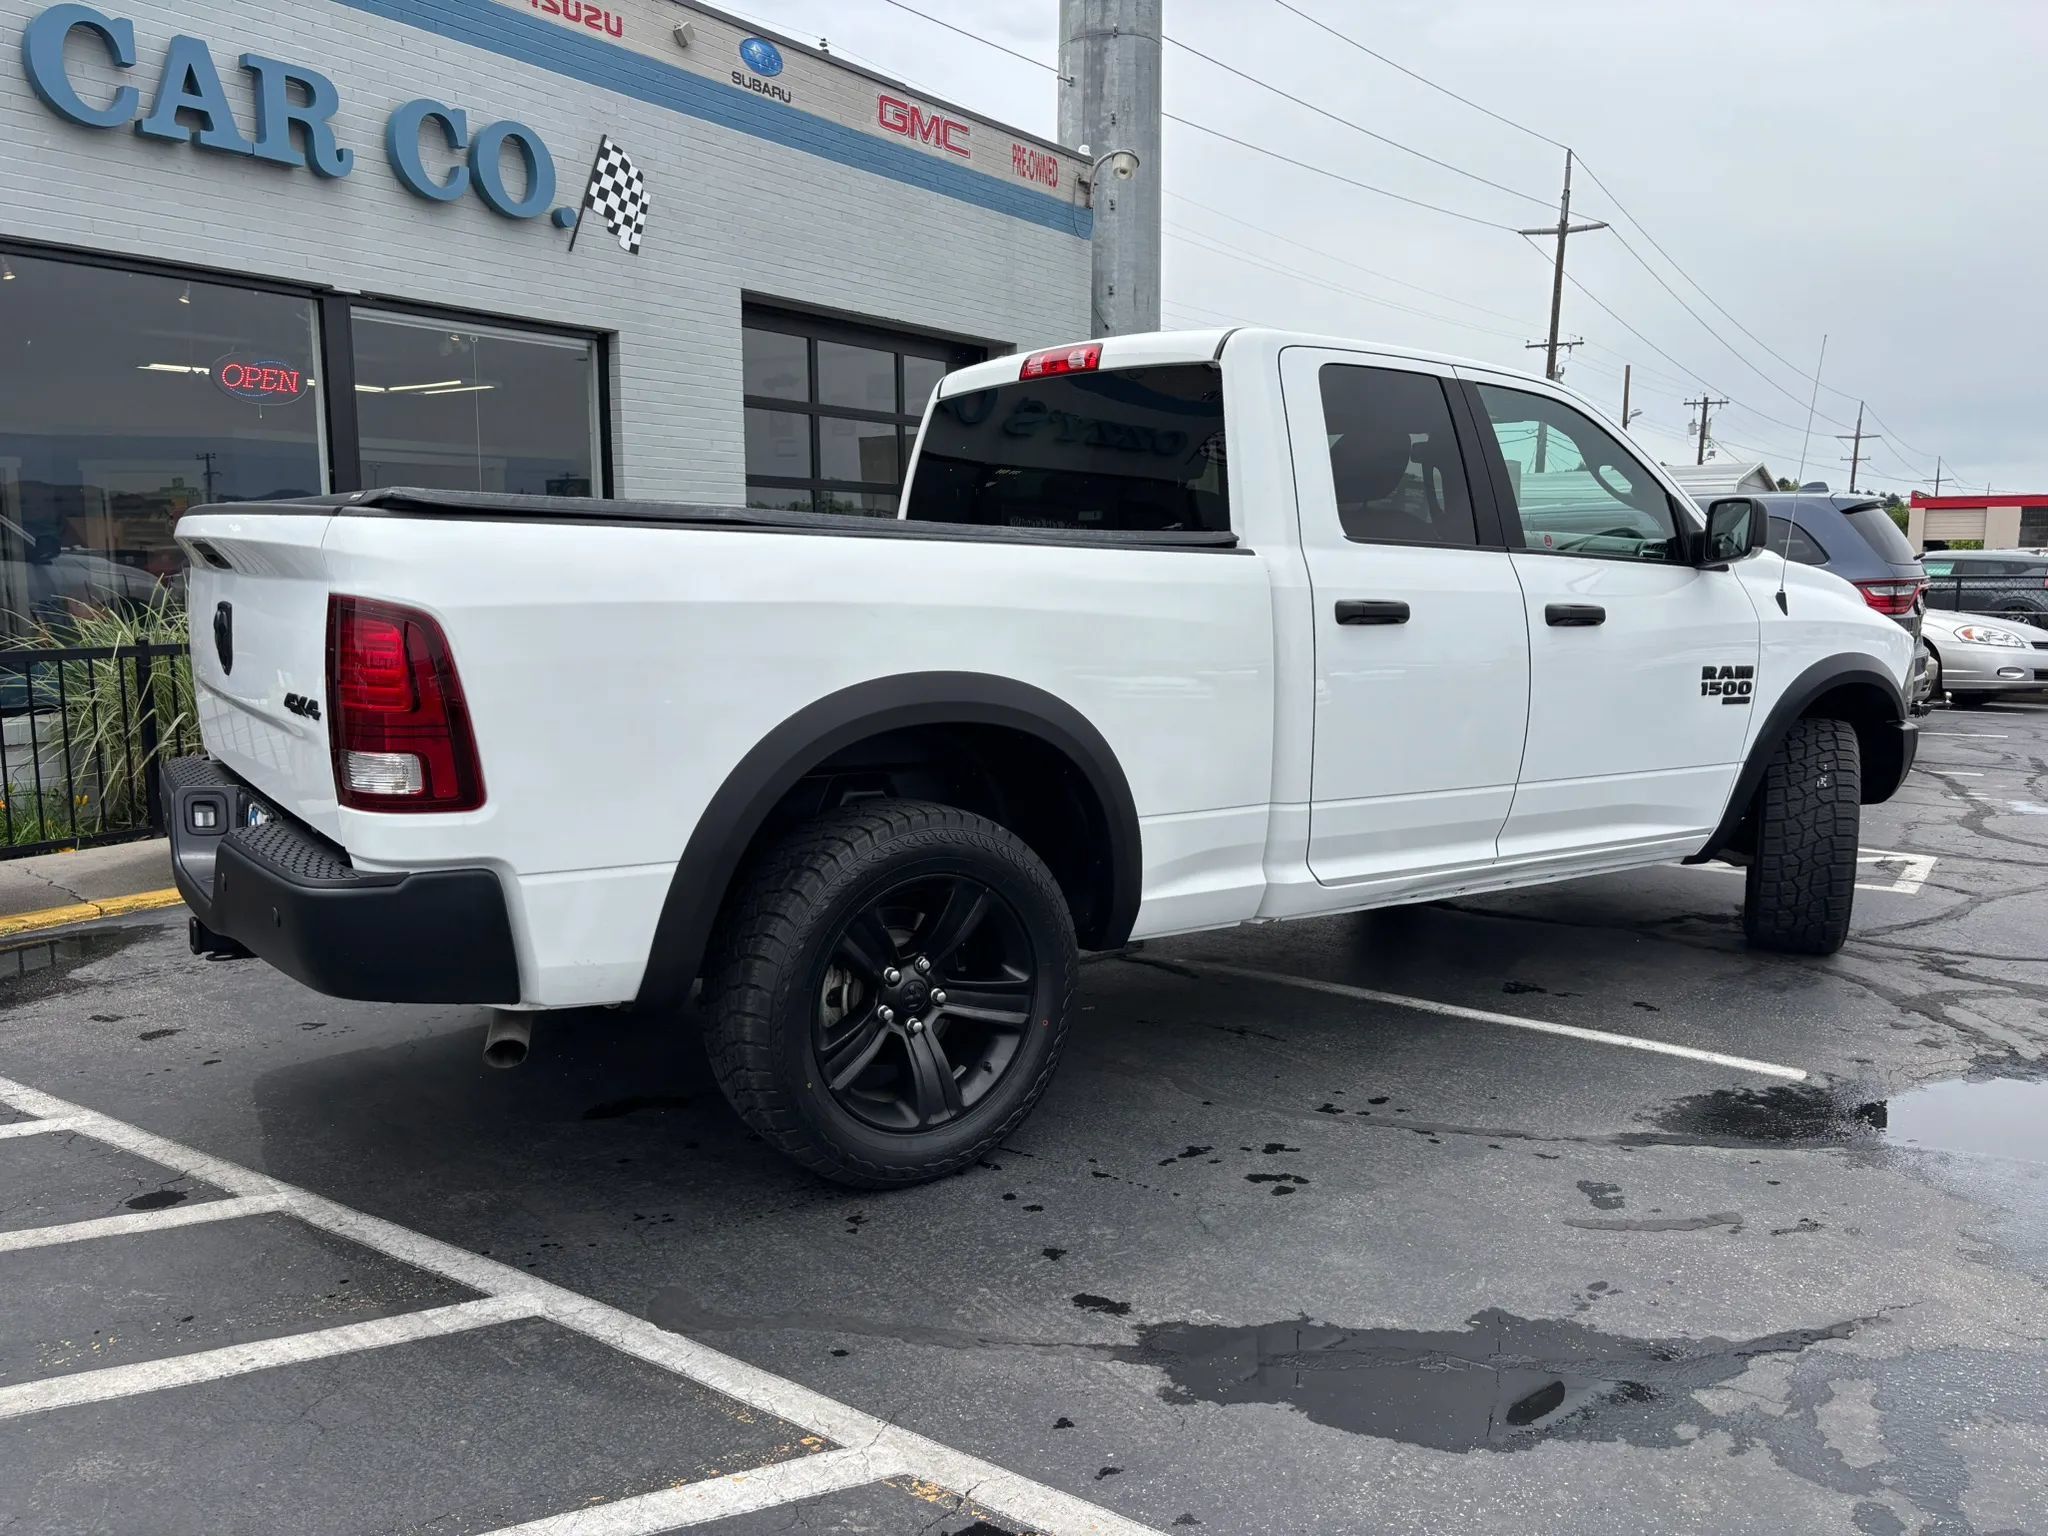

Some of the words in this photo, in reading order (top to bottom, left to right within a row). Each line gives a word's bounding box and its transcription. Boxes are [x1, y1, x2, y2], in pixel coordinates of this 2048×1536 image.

[731, 71, 792, 103] SUBARU
[22, 3, 354, 179] CAR
[387, 98, 577, 230] CO.
[877, 93, 970, 159] GMC
[1012, 143, 1059, 187] PRE-OWNED
[221, 363, 300, 393] OPEN
[1702, 665, 1755, 680] RAM
[1701, 681, 1753, 697] 1500
